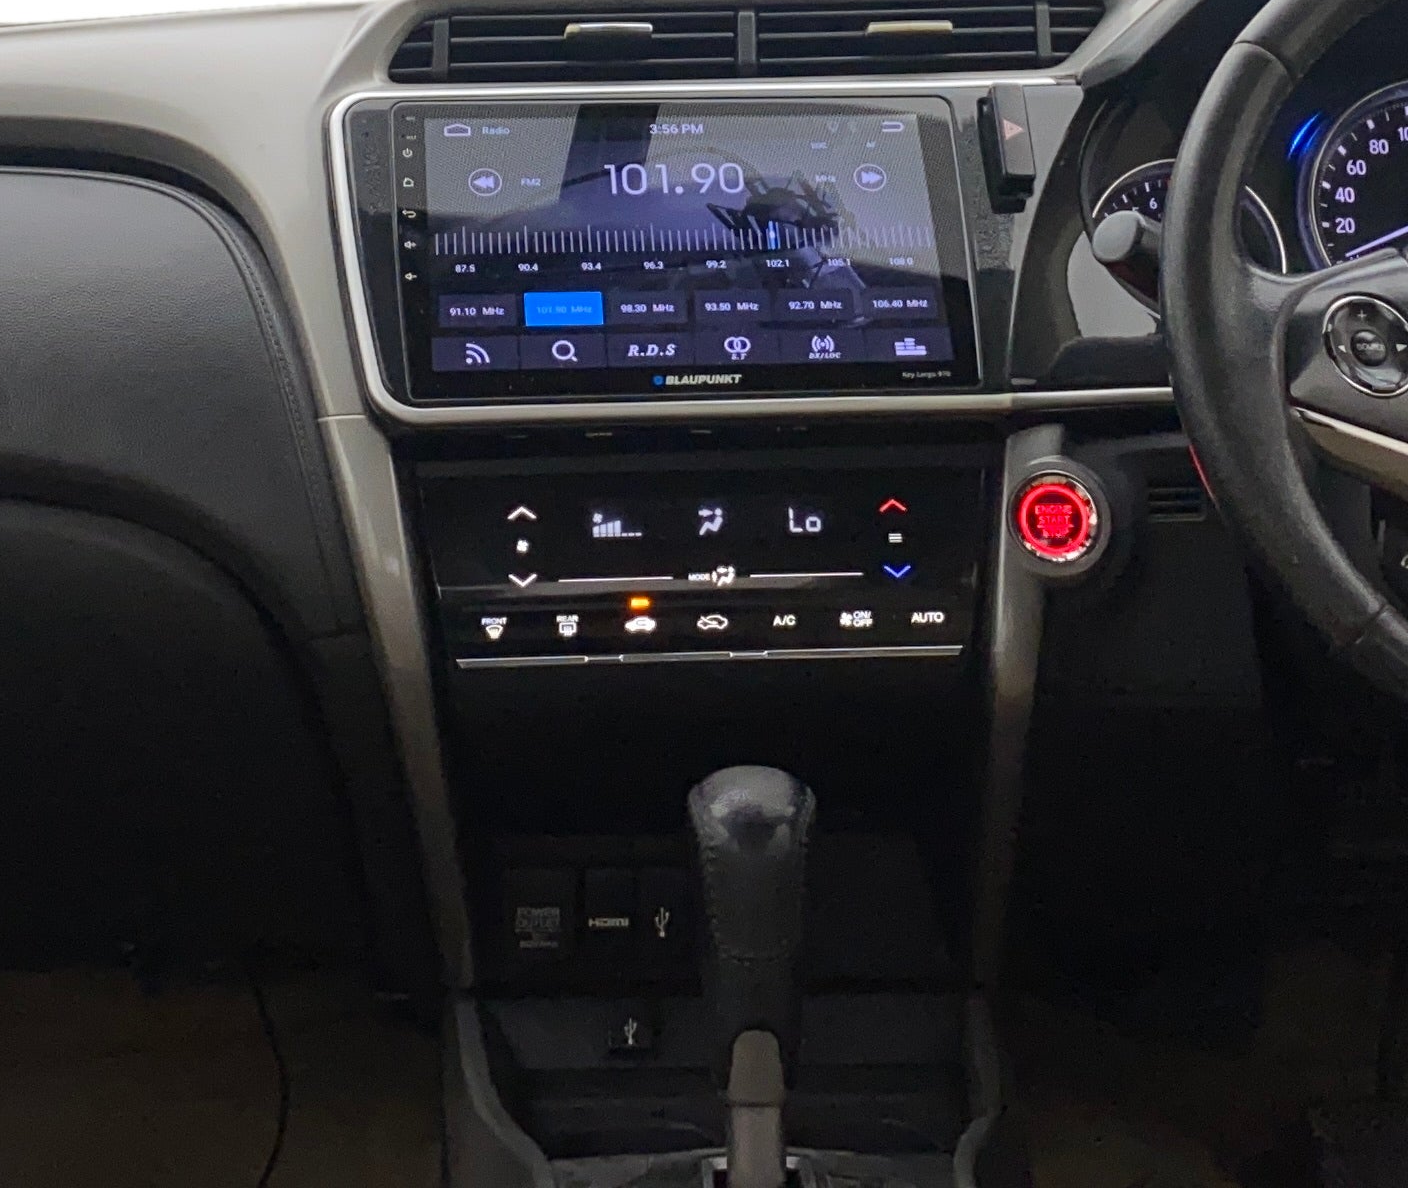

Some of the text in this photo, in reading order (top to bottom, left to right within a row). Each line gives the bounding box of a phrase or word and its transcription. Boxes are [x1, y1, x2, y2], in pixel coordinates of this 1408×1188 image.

[482, 125, 510, 136] Radio
[681, 123, 704, 134] PM
[1369, 139, 1390, 155] 80
[1346, 159, 1367, 176] 60
[603, 163, 744, 196] 101.90
[1334, 187, 1356, 203] 40
[1149, 197, 1158, 210] 6
[1335, 218, 1356, 234] 20
[454, 263, 476, 274] 87.5
[518, 263, 539, 273] 90.4
[581, 262, 602, 272] 93.4
[643, 260, 665, 271] 96.3
[706, 259, 728, 270] 99.2
[766, 258, 790, 268] 102.1
[620, 303, 675, 313] 98.30 MHz
[737, 301, 760, 311] MHz
[788, 300, 843, 310] 92.70 MHz
[906, 299, 928, 308] MHz
[449, 306, 506, 317] 91.10 MHz
[665, 373, 743, 386] BLAUPUNKT
[1038, 515, 1071, 525] START
[688, 572, 711, 582] MODE
[481, 616, 508, 626] FRONT
[556, 614, 580, 623] REAR
[772, 614, 797, 628] A/C
[853, 618, 874, 628] OFF
[911, 611, 946, 624] AUTO
[588, 917, 630, 928] HDMI
